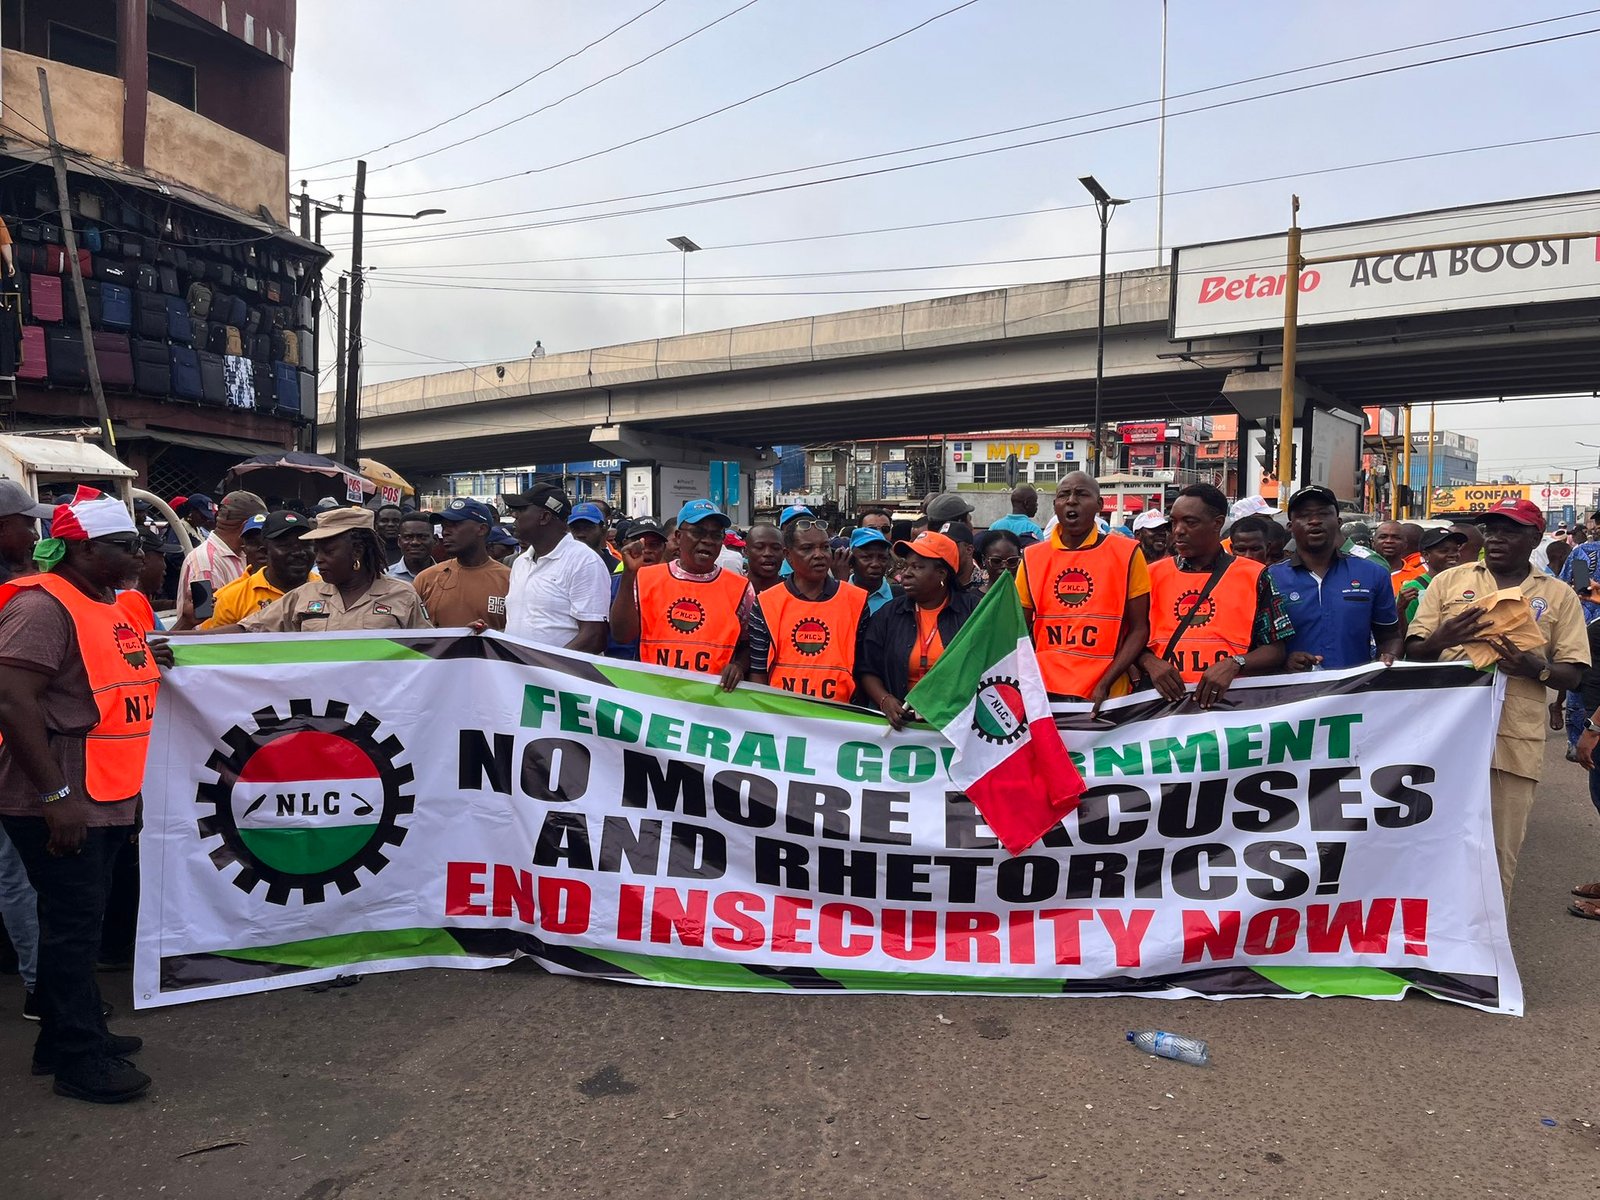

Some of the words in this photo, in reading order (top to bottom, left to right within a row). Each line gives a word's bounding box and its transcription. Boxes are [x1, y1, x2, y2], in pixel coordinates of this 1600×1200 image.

[1350, 250, 1437, 288] ACCA
[987, 442, 1040, 460] MVP
[348, 478, 361, 492] POS
[382, 486, 399, 502] POS
[1465, 490, 1522, 500] KONFAM
[1046, 625, 1098, 646] NLC
[656, 648, 711, 672] NLC
[781, 677, 837, 699] NLC
[991, 699, 1009, 720] NLC
[520, 684, 816, 776] FEDERAL
[837, 714, 1363, 783] GONMENT
[458, 729, 591, 802] NO
[621, 749, 912, 846] MORE
[276, 791, 340, 816] NLC
[532, 810, 728, 880] AND
[755, 836, 1347, 904] RHETORICS!
[445, 861, 592, 934] END
[616, 884, 1154, 968] INSECURITY
[1181, 898, 1429, 964] NOW!
